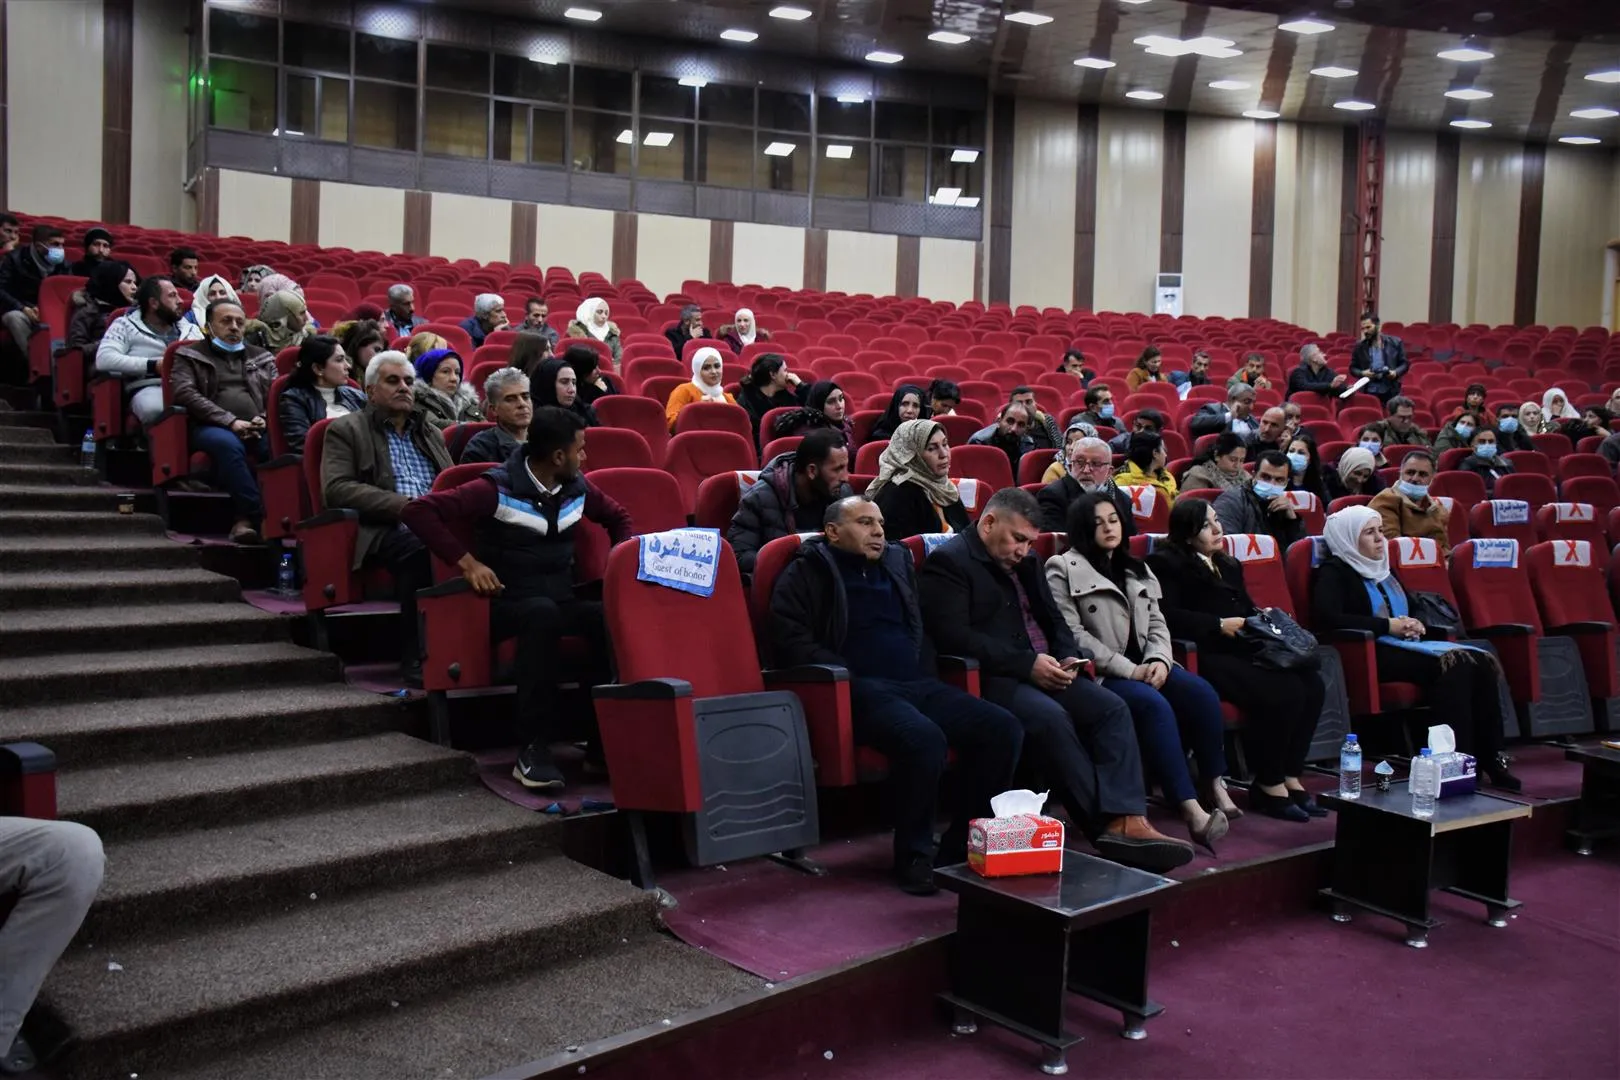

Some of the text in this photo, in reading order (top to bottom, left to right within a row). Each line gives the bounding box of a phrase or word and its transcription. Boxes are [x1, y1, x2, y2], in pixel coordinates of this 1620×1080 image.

[649, 535, 714, 568] ضيف شرف
[652, 561, 707, 581] Guest of honor
